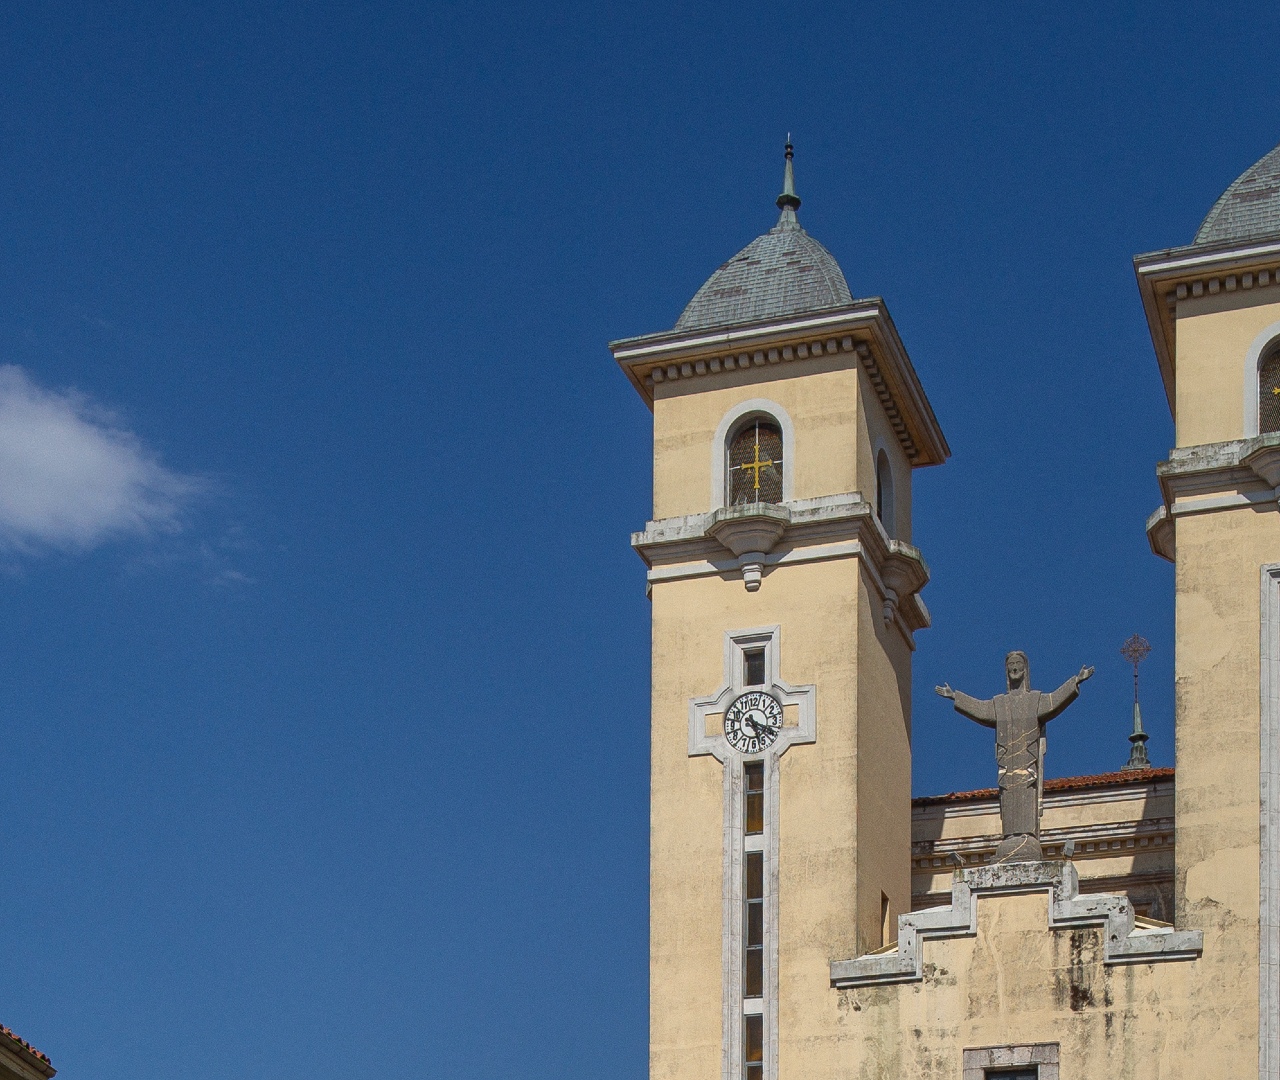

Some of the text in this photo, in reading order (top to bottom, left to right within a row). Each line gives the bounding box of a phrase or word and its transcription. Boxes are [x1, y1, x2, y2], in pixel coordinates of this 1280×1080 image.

[741, 701, 748, 710] 11
[749, 697, 758, 707] 12
[769, 705, 775, 715] 2
[733, 711, 741, 720] 10
[772, 715, 778, 725] 3
[733, 731, 738, 741] 8
